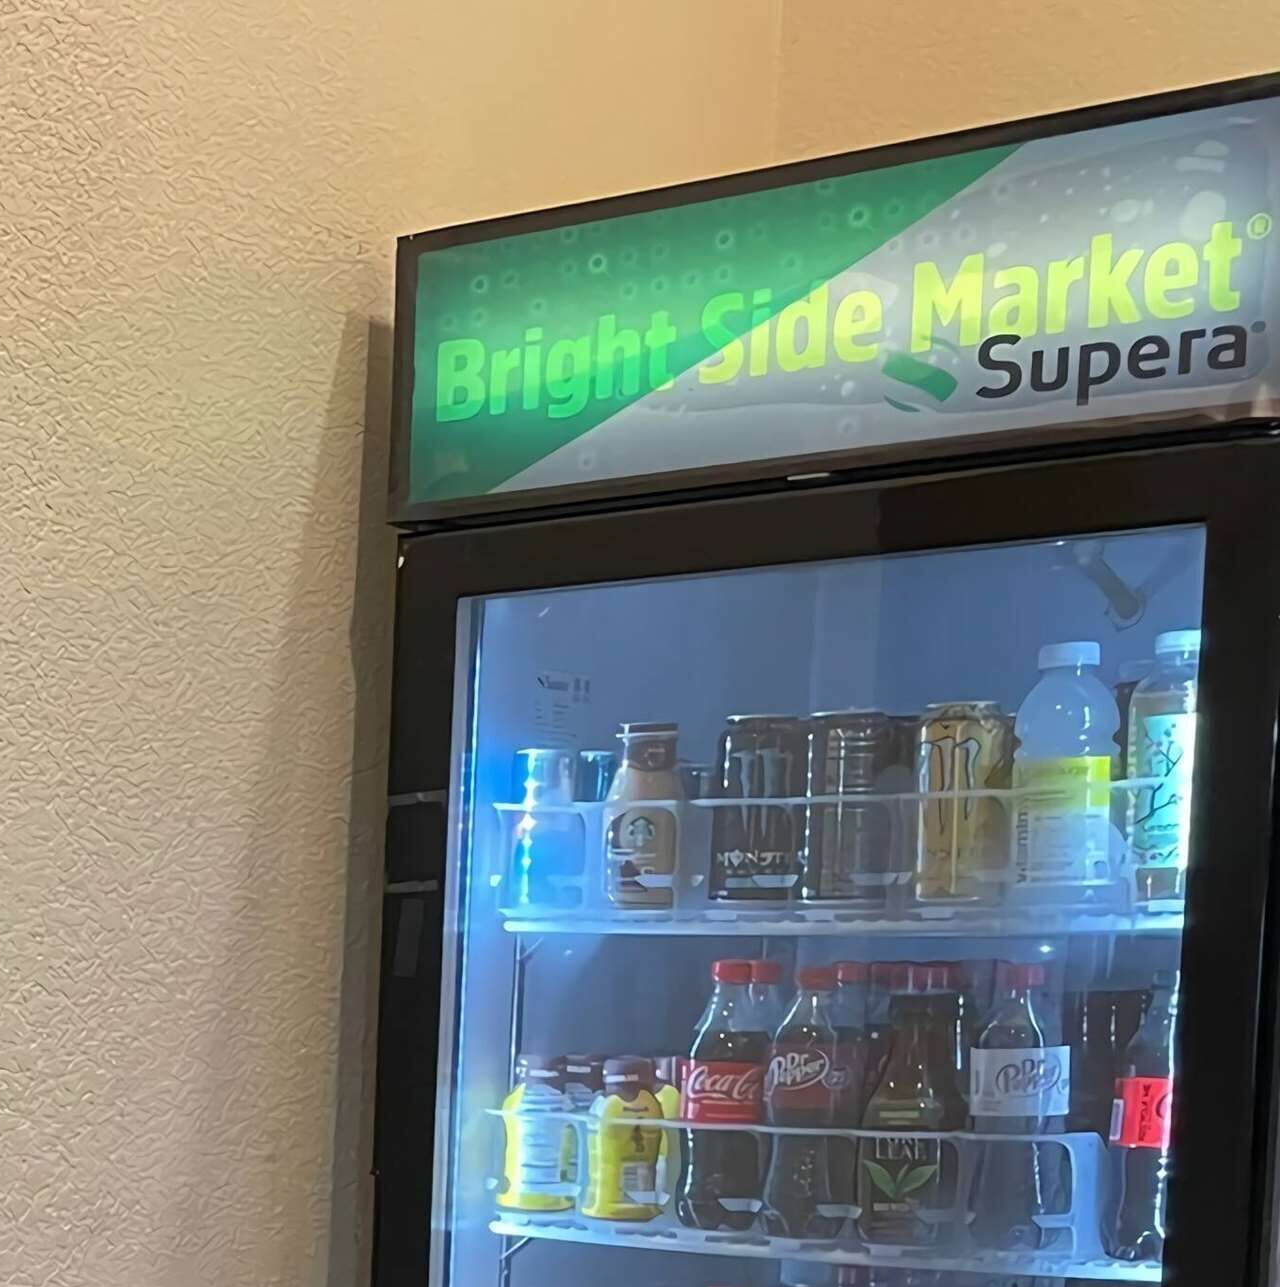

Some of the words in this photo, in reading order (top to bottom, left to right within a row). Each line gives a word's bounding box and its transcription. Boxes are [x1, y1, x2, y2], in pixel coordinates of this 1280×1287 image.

[435, 313, 675, 423] Bright
[697, 284, 884, 387] Side
[911, 219, 1244, 354] Market
[975, 322, 1246, 406] Supera
